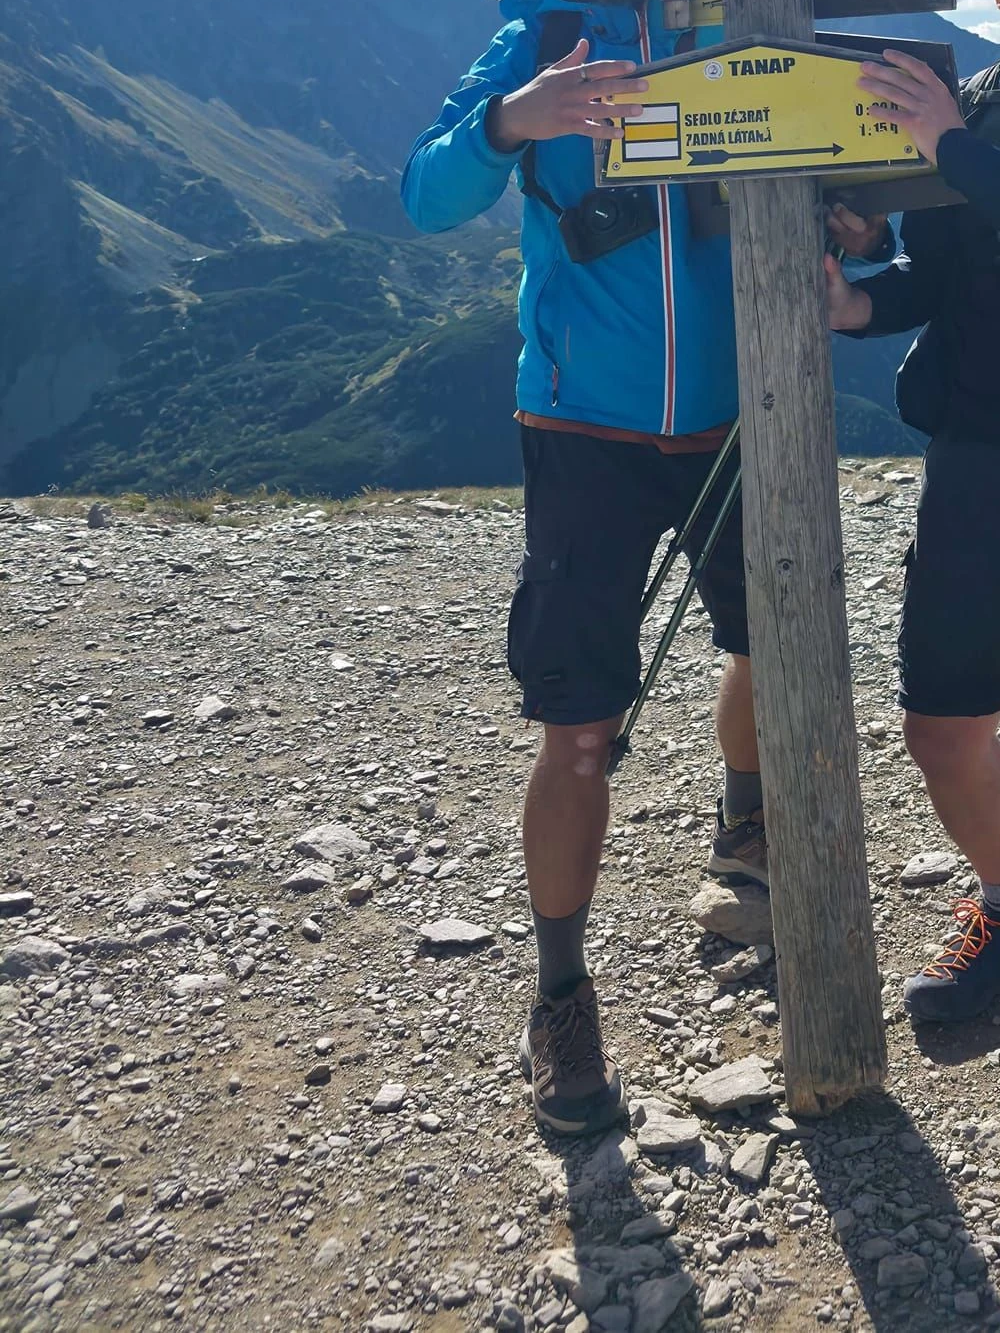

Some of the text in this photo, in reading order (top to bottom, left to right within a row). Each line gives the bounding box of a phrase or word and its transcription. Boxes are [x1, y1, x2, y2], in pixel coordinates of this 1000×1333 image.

[728, 57, 796, 77] TANAP
[684, 112, 722, 127] SEDLO
[686, 129, 726, 147] ZADNÁ
